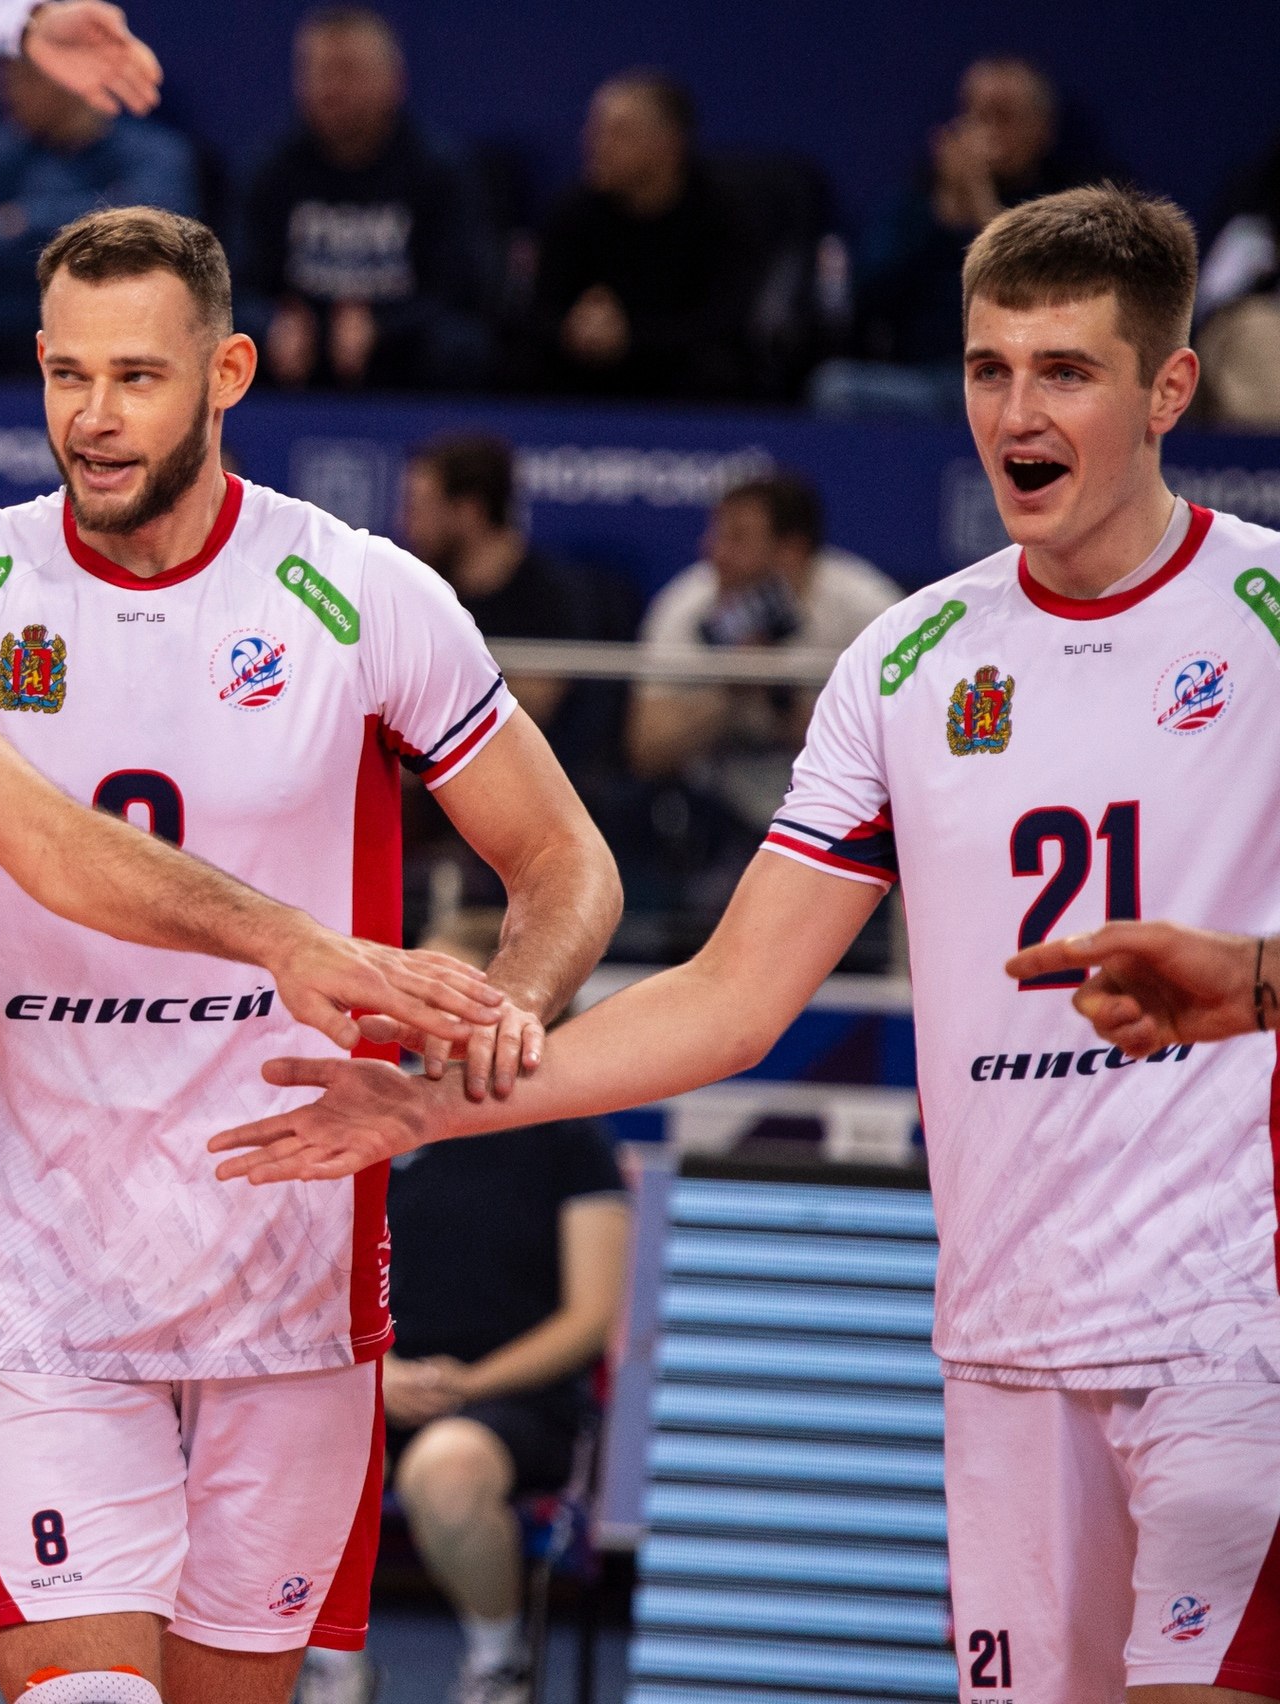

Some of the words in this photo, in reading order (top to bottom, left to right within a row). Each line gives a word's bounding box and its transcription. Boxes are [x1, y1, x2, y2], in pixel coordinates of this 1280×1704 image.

[302, 578, 352, 632] МЕГАФОН
[901, 609, 955, 664] МЕАФОН
[1009, 799, 1142, 992] 21
[5, 985, 276, 1024] ЕНИСЕЙ
[31, 1509, 69, 1567] 8
[968, 1629, 1012, 1689] 21
